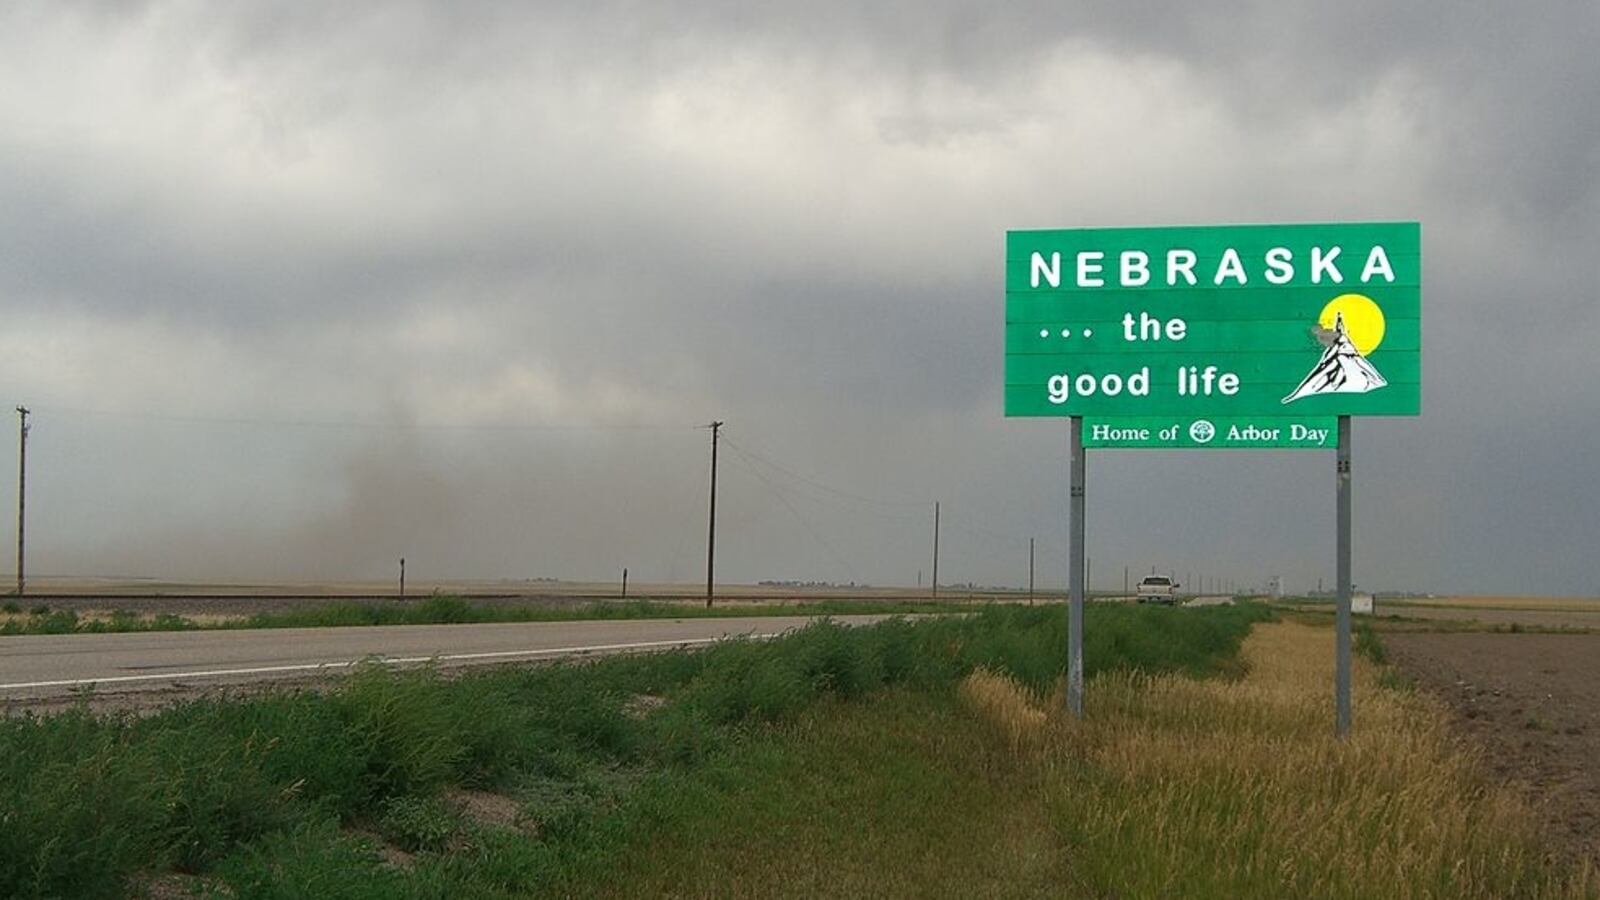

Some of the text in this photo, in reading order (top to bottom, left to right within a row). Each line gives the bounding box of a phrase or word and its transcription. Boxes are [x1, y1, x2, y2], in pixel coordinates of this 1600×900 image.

[1030, 245, 1396, 288] NEBRASKA
[1122, 312, 1187, 341] the
[1048, 366, 1240, 404] good life
[1092, 424, 1329, 445] Home of Arbor Day
